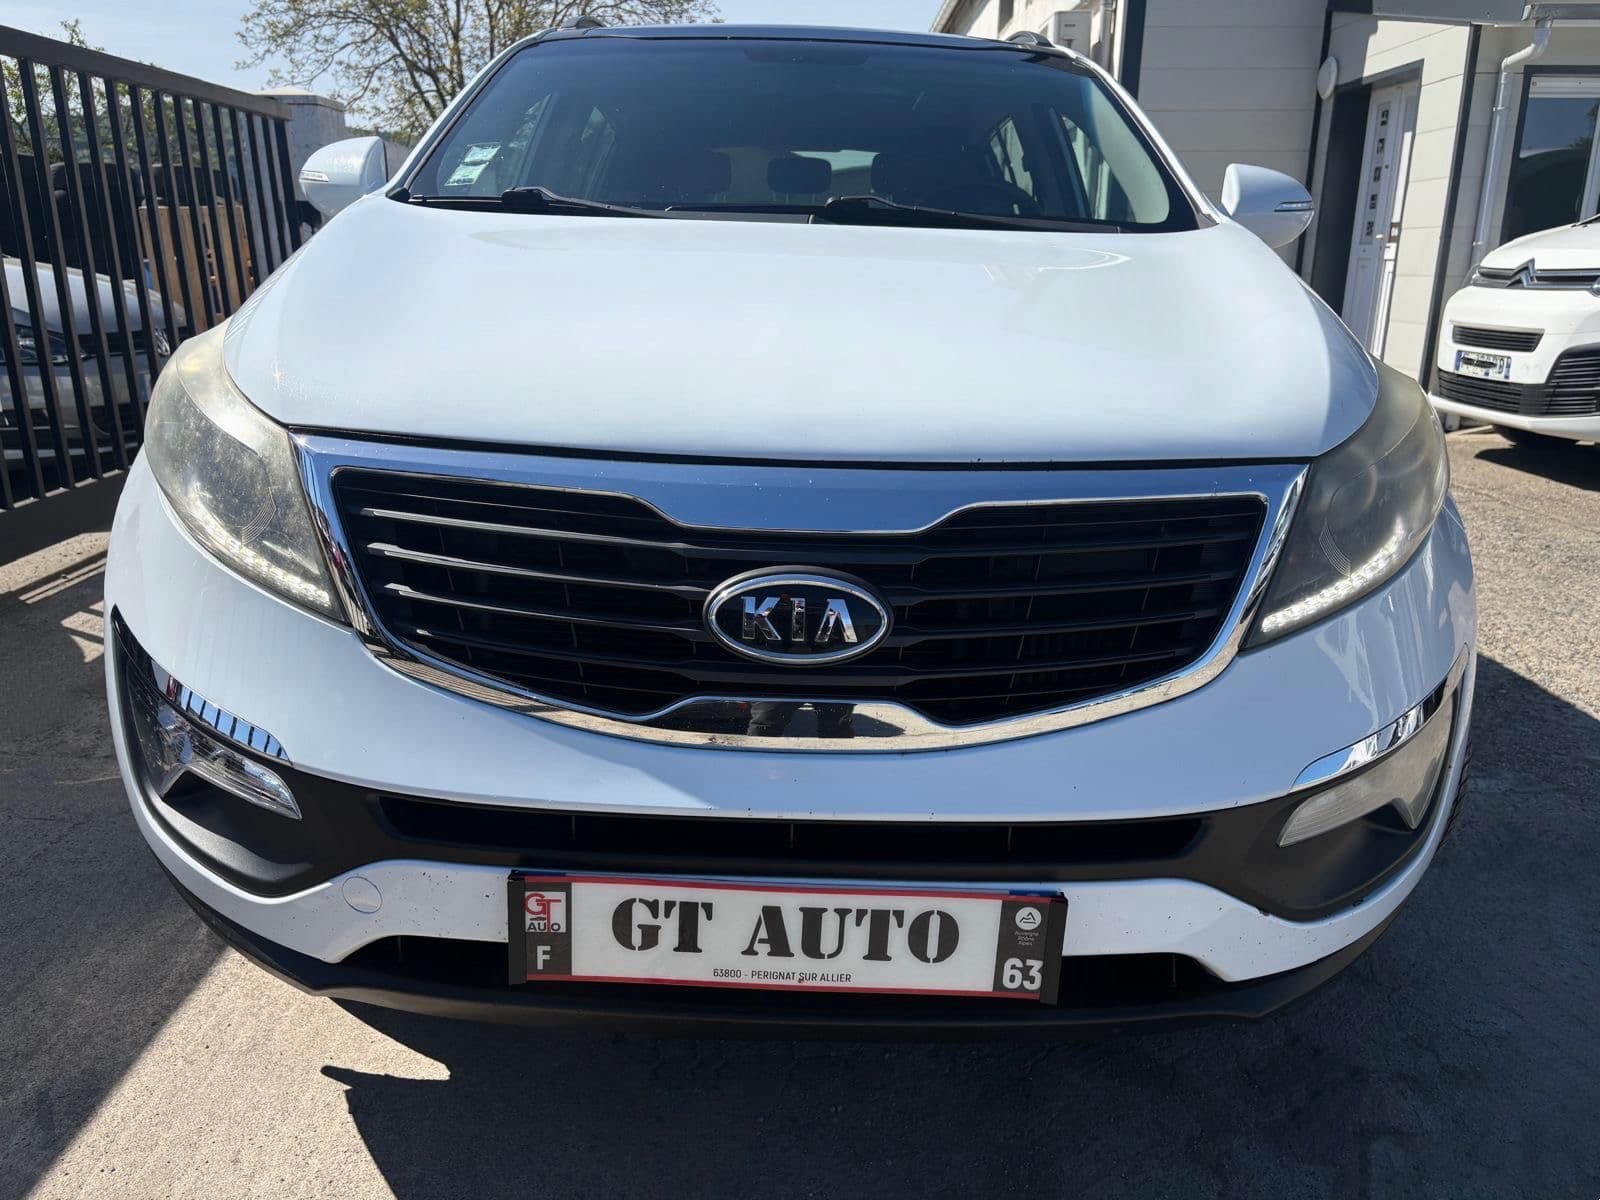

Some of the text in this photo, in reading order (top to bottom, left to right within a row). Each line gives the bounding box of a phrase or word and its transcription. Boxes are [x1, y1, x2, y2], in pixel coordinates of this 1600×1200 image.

[741, 596, 858, 643] KIA
[523, 892, 562, 929] GT
[528, 922, 561, 932] AUTO
[612, 898, 960, 964] GT AUTO
[537, 945, 551, 970] F
[1002, 957, 1043, 990] 63
[713, 968, 742, 978] 63800
[751, 970, 796, 981] PERIGNAT
[798, 972, 818, 983] SUR
[819, 973, 852, 983] ALLIER
